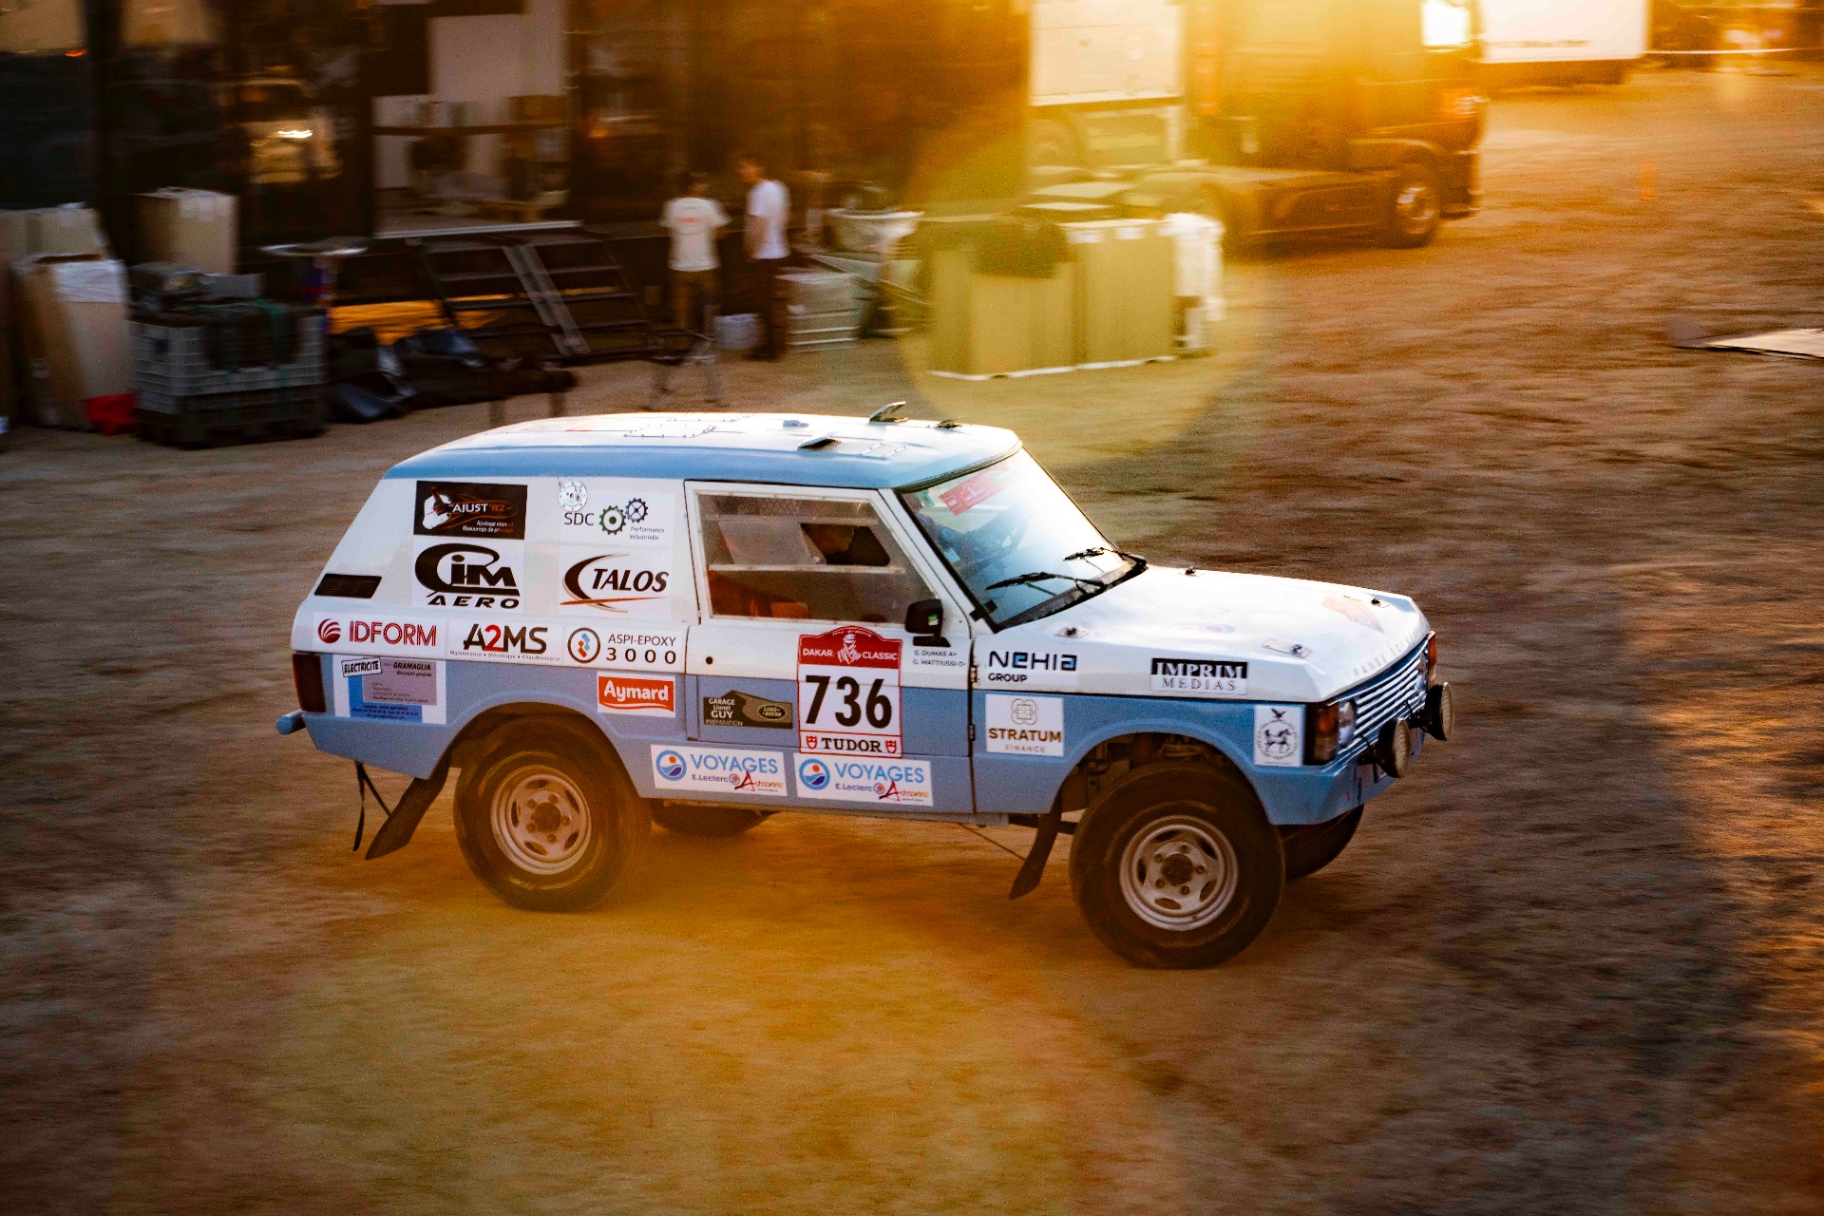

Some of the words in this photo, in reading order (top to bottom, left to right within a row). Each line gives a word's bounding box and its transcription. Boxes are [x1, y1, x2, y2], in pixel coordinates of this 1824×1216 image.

[564, 512, 594, 526] SDC
[428, 595, 519, 609] AERO
[349, 620, 437, 647] IDFORM
[463, 623, 548, 654] A2MS
[608, 634, 677, 647] ASPI-EPOXY
[606, 647, 676, 664] 3000
[802, 648, 833, 657] DAKAR
[862, 651, 898, 660] CLASSIC
[393, 662, 431, 671] GRAMAGLIA
[1156, 662, 1243, 678] IMPRIM
[988, 672, 1027, 683] GROUP
[1162, 677, 1236, 692] MEDIAS
[603, 680, 668, 702] Aymard
[708, 698, 735, 706] GARAGE
[805, 674, 892, 729] 736
[711, 711, 733, 719] GUY
[989, 727, 1062, 743] STRATUM
[821, 737, 882, 753] TUDOR
[1005, 744, 1045, 753] FINANCE
[690, 753, 779, 774] VOYAGES
[692, 773, 729, 783] E.Leclerc
[834, 762, 925, 783] VOYAGES
[835, 783, 873, 792] E.Leclerc
